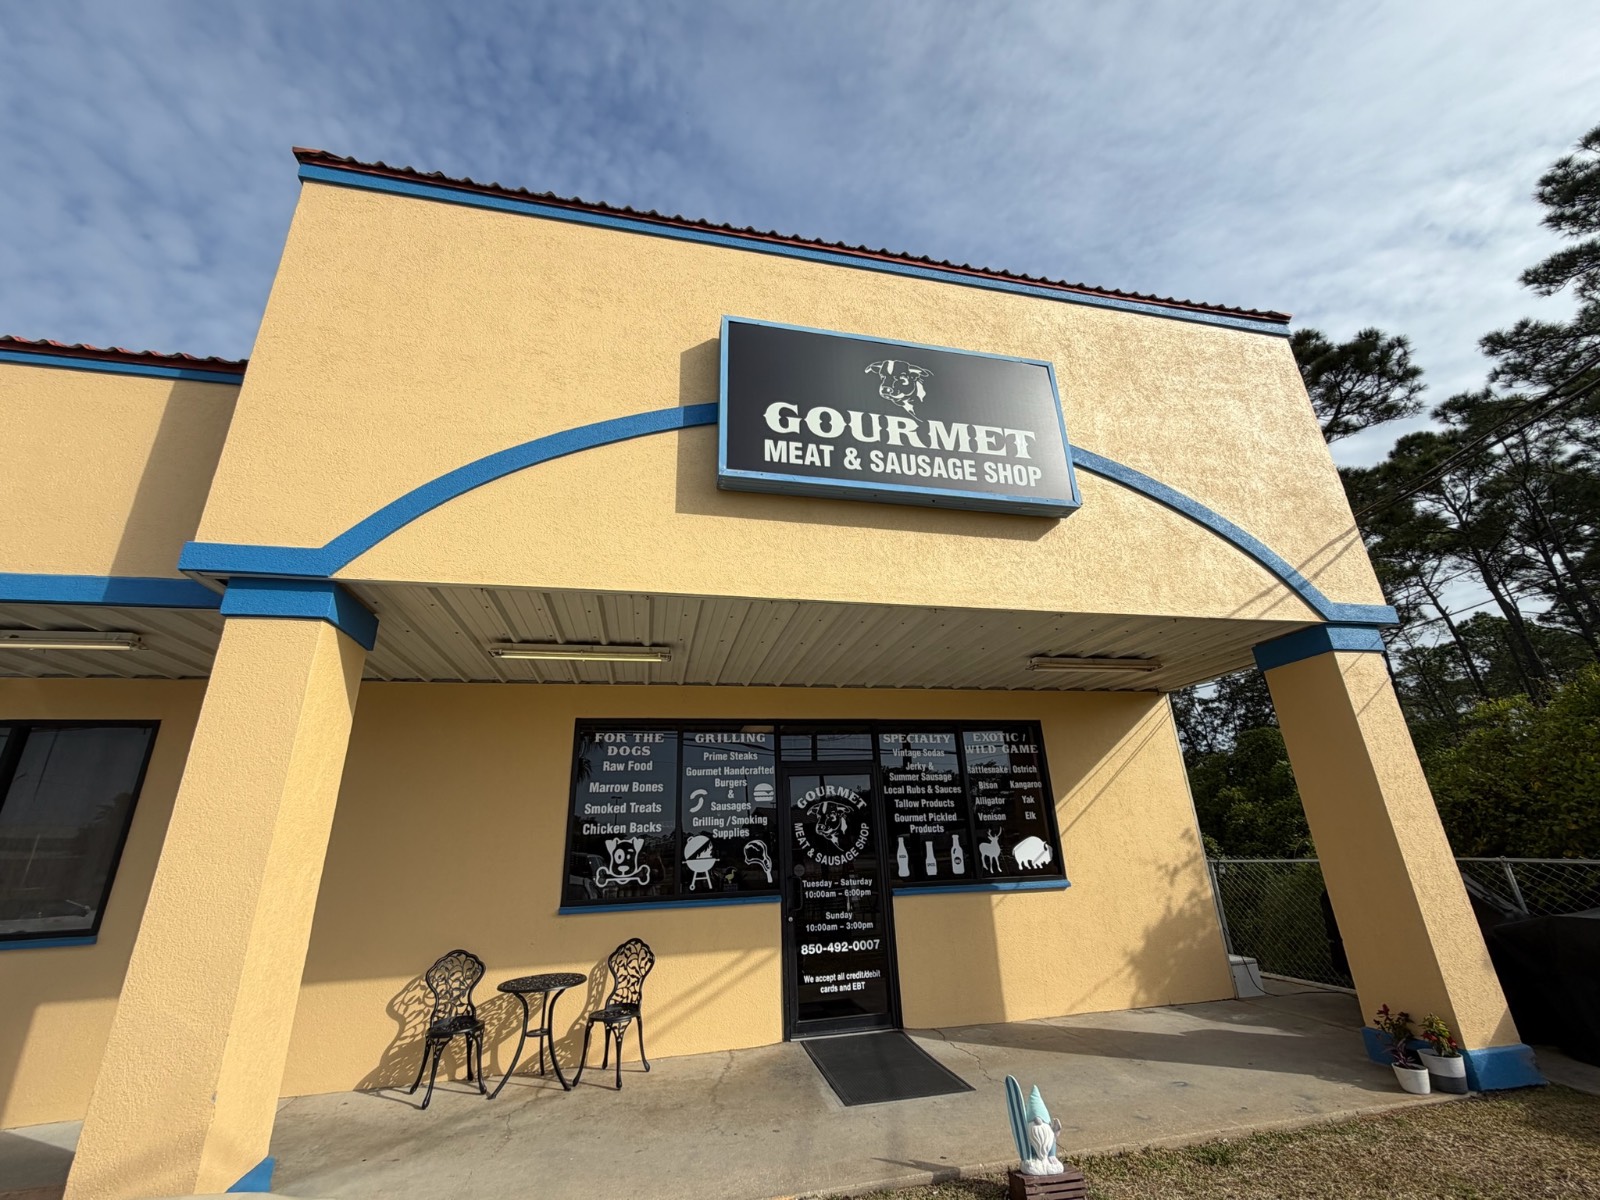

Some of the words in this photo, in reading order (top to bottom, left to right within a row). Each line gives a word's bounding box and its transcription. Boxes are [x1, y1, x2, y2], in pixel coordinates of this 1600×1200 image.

[763, 402, 1036, 459] GOURMET
[764, 440, 834, 467] MEAT
[844, 447, 862, 470] &
[870, 450, 977, 481] SAUSAGE
[984, 461, 1042, 487] SHOP
[595, 733, 626, 742] FOR
[633, 733, 664, 742] THE
[695, 734, 766, 743] GRILLING
[883, 734, 950, 743] SPECIALTY
[973, 733, 1019, 741] EXOTIC
[607, 746, 651, 756] DOGS
[893, 748, 920, 758] Vintage
[965, 745, 996, 753] WILD
[1002, 745, 1038, 753] GAME
[704, 752, 728, 761] Prime
[603, 762, 626, 771] Raw
[628, 761, 652, 771] Food
[686, 767, 721, 776] Gourmet
[724, 766, 774, 775] Handcrafted
[906, 762, 926, 771] Jerky
[928, 762, 934, 770] &
[921, 773, 952, 782] Sausage
[589, 782, 629, 793] Marrow
[632, 782, 664, 792] Bones
[715, 778, 747, 788] Burgers
[1010, 781, 1042, 789] Kangaroo
[728, 790, 734, 798] &
[884, 786, 904, 794] Local
[906, 785, 925, 794] Rubs
[935, 785, 961, 793] Sauces
[797, 785, 867, 809] GOURMET
[976, 797, 1005, 806] Alligator
[584, 803, 626, 814] Smoked
[630, 802, 662, 813] Treats
[711, 802, 751, 812] Sausages
[894, 799, 919, 808] Tallow
[921, 799, 954, 807] Products
[693, 817, 724, 827] Grilling
[894, 814, 926, 822] Gourmet
[929, 813, 957, 821] Pickled
[978, 813, 1006, 821] Venison
[583, 823, 626, 835] Chicken
[630, 822, 661, 833] Backs
[712, 828, 750, 839] Supplies
[910, 825, 944, 833] Products
[794, 823, 810, 849] MEAT
[807, 848, 814, 858] &
[815, 847, 859, 866] SAUSAGE
[856, 823, 870, 849] SHOP
[826, 911, 852, 920] Sunday
[801, 939, 880, 955] 850-492-0007
[815, 974, 836, 983] accept
[846, 970, 880, 980] credit/debit
[820, 985, 838, 993] cards
[853, 982, 865, 990] EBT
